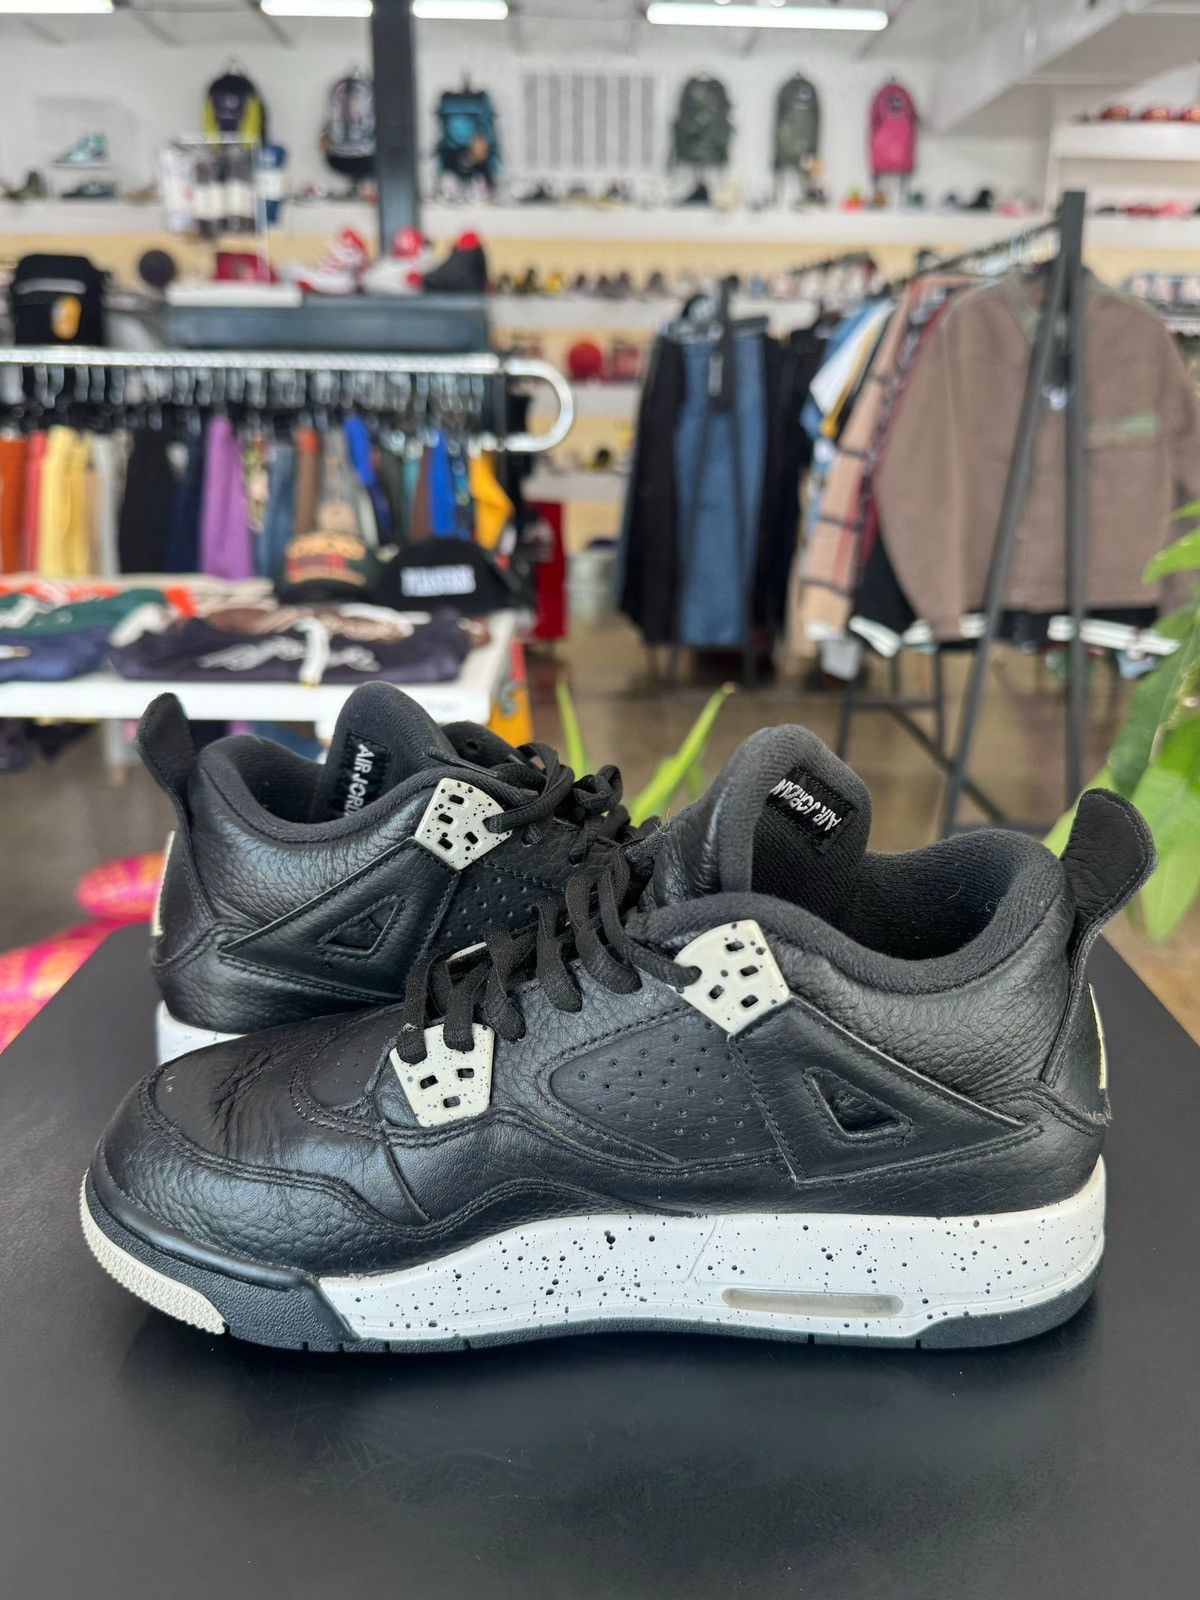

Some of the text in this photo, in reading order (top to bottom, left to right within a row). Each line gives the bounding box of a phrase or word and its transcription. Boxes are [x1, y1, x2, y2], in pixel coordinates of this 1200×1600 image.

[353, 743, 375, 773] AIR
[769, 778, 842, 831] AIR JORDAN
